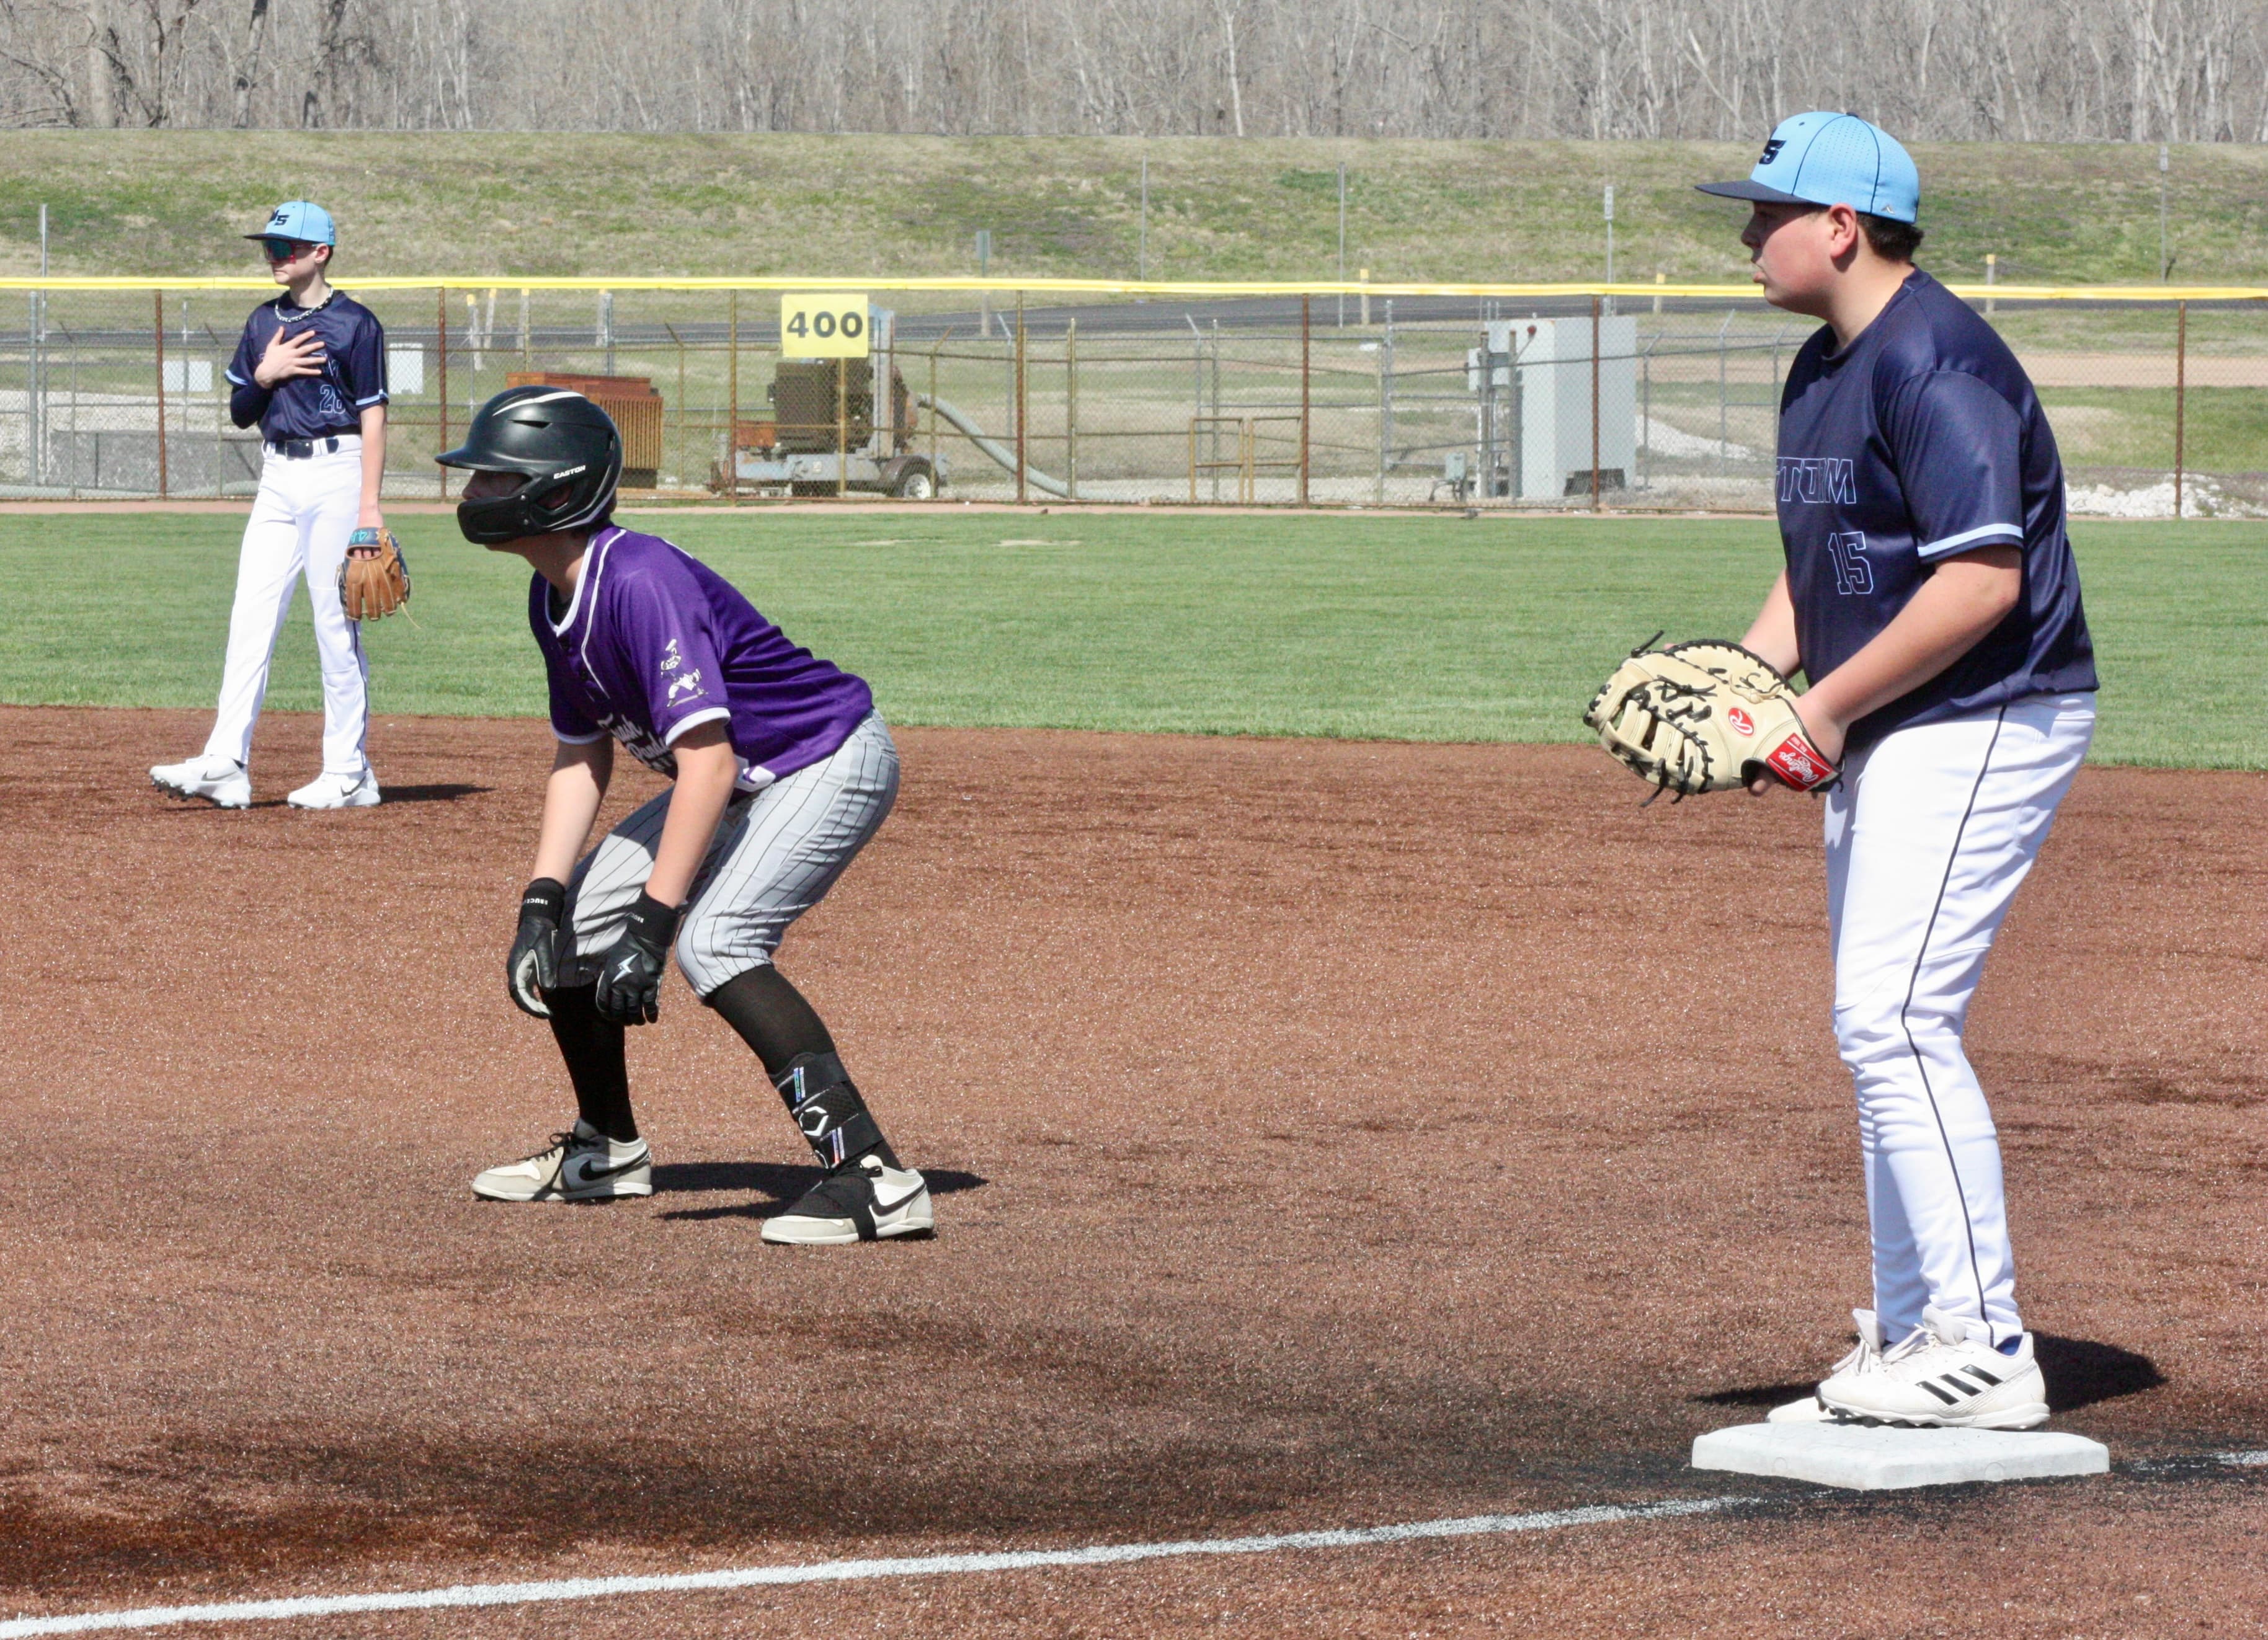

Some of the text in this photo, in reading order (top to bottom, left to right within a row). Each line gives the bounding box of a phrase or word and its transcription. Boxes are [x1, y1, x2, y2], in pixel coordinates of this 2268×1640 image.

[786, 311, 863, 338] 400
[553, 464, 586, 479] EASTON
[1828, 531, 1874, 595] 15
[1779, 751, 1818, 782] Rawlings
